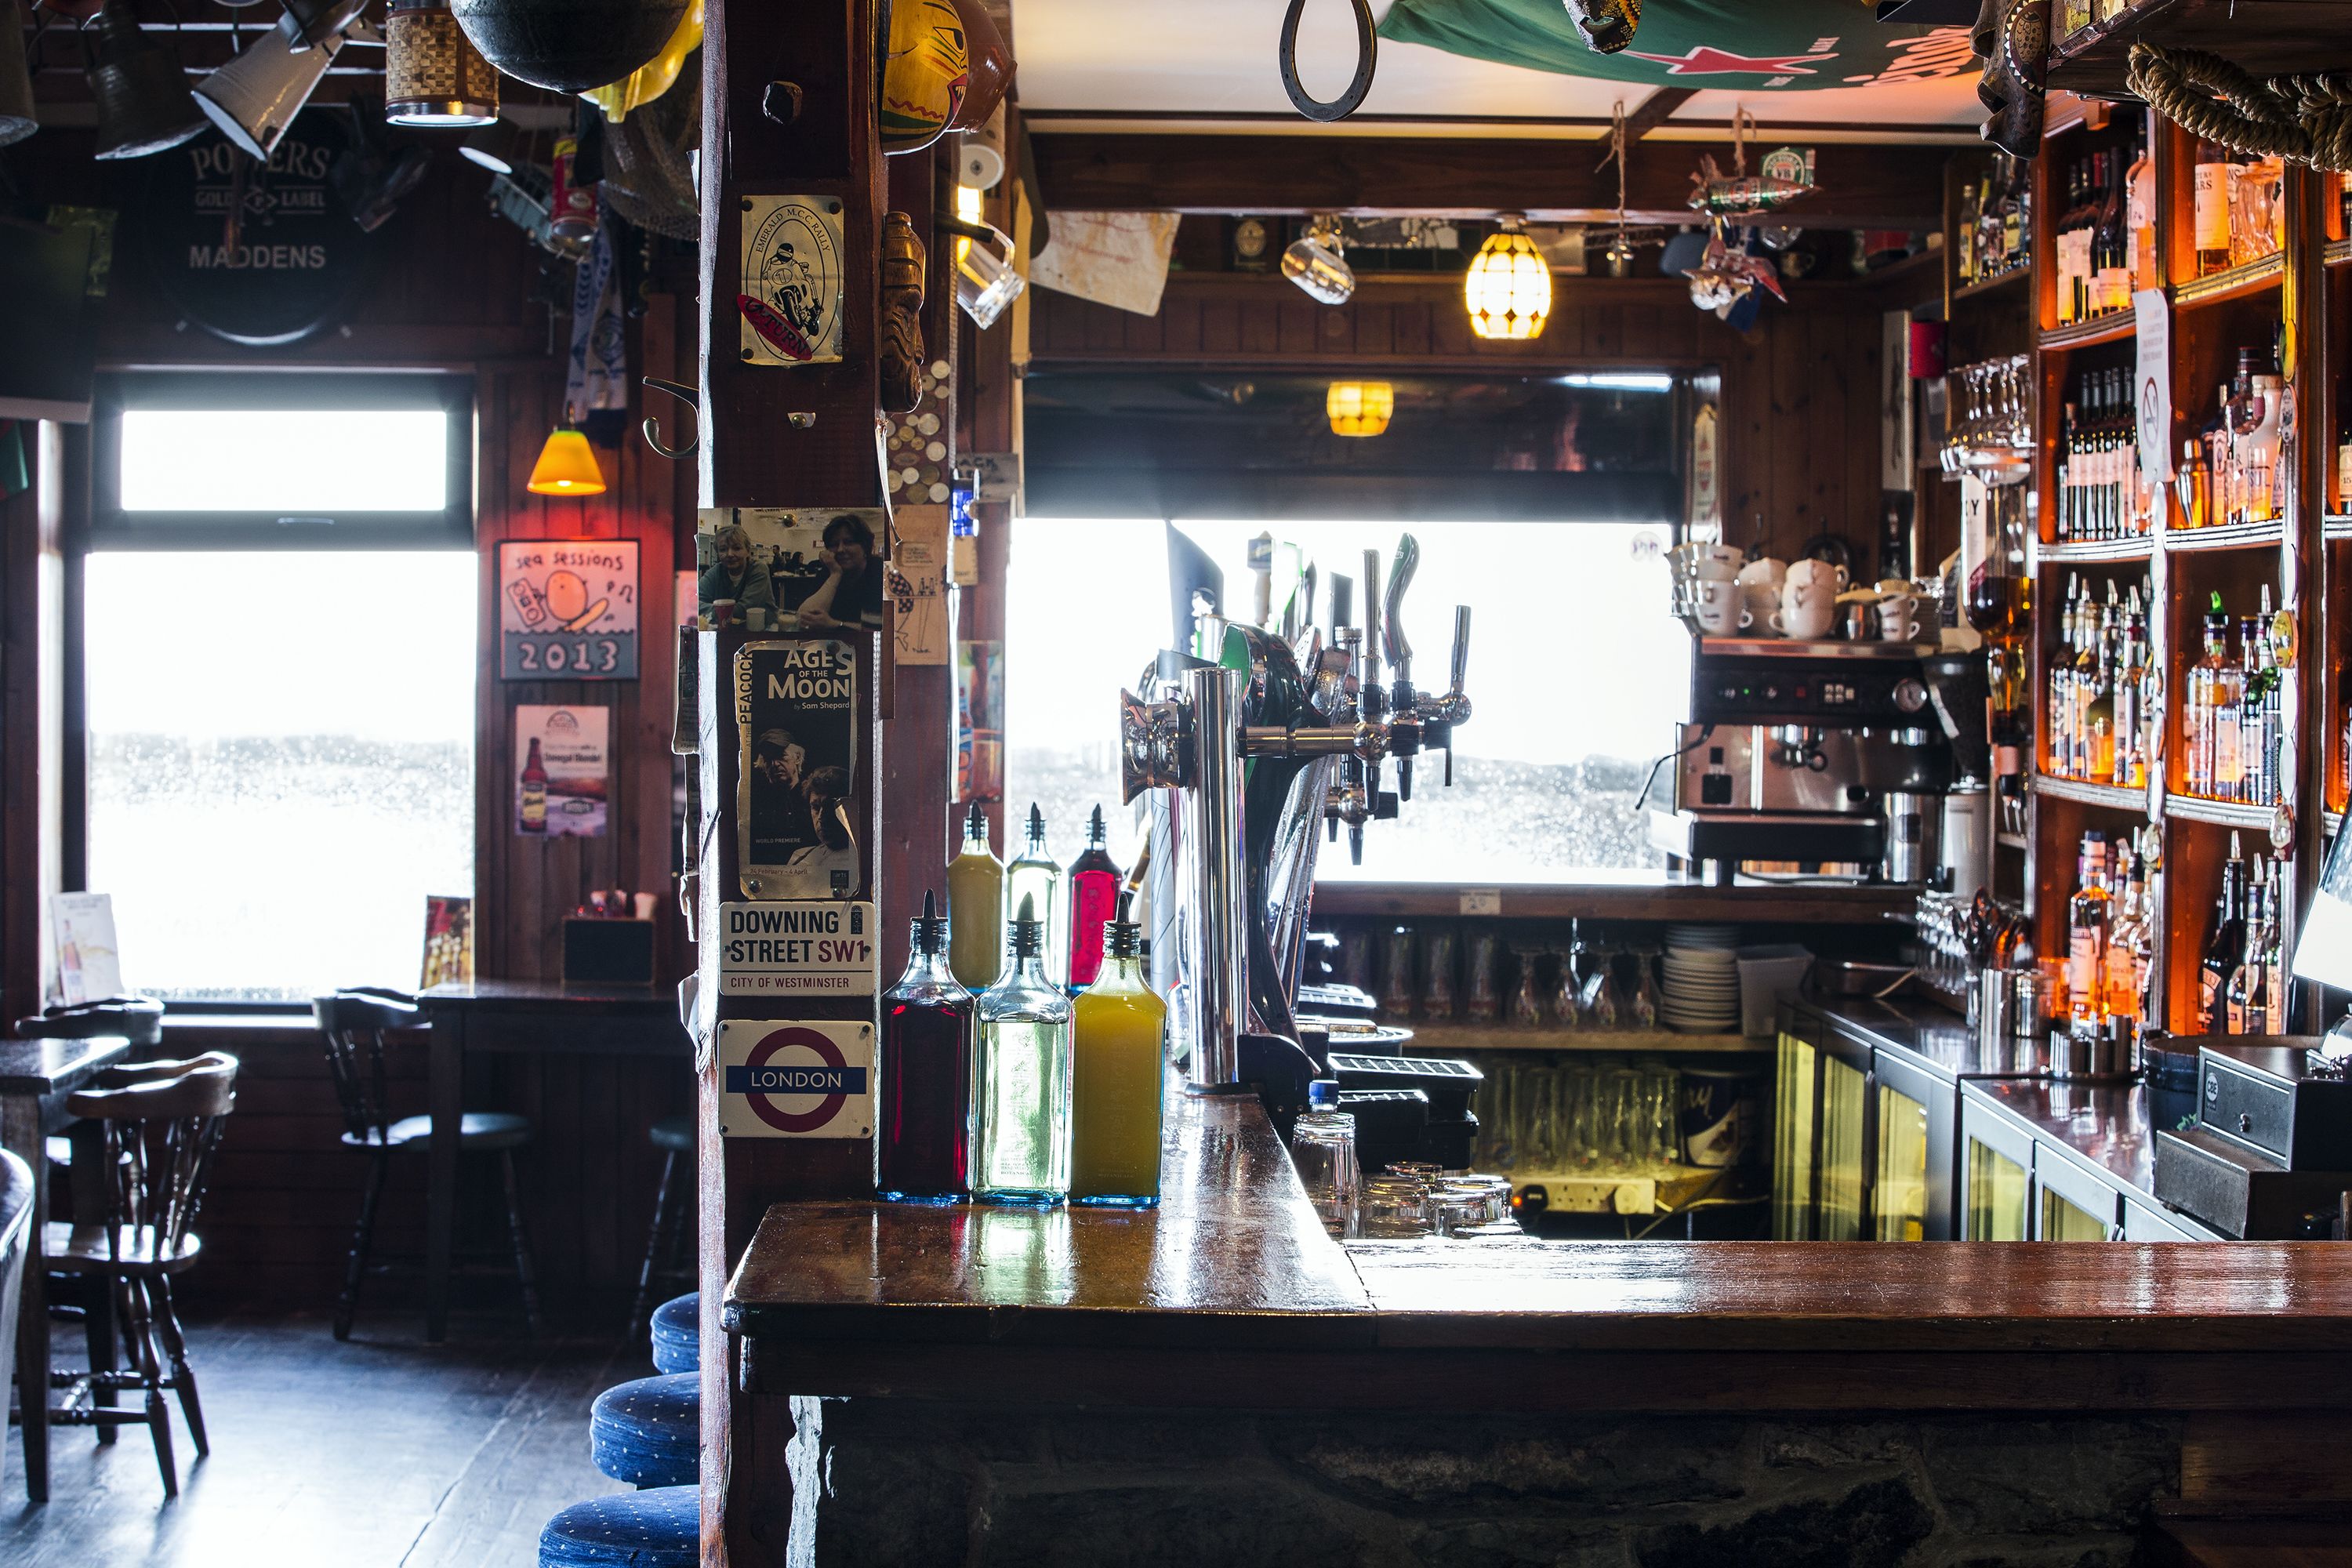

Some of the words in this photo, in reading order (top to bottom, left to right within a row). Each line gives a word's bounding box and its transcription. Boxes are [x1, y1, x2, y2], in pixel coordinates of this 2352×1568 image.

[189, 141, 330, 181] POERS
[756, 212, 784, 253] EMERALD
[811, 222, 831, 252] RALLY
[188, 245, 326, 269] MADDENS
[516, 554, 543, 569] sea
[554, 550, 624, 571] sessions
[518, 639, 619, 672] 2013
[784, 649, 854, 676] AGES
[739, 651, 752, 724] PEACOCK
[768, 673, 850, 699] MOON
[820, 701, 850, 710] Shepard
[731, 910, 839, 934] DOWNING
[731, 939, 814, 964] STREET
[818, 940, 865, 963] SW1
[731, 977, 753, 988] CITY
[757, 977, 771, 988] OF
[775, 977, 849, 988] WESTMINSTER
[751, 1071, 841, 1087] LONDON
